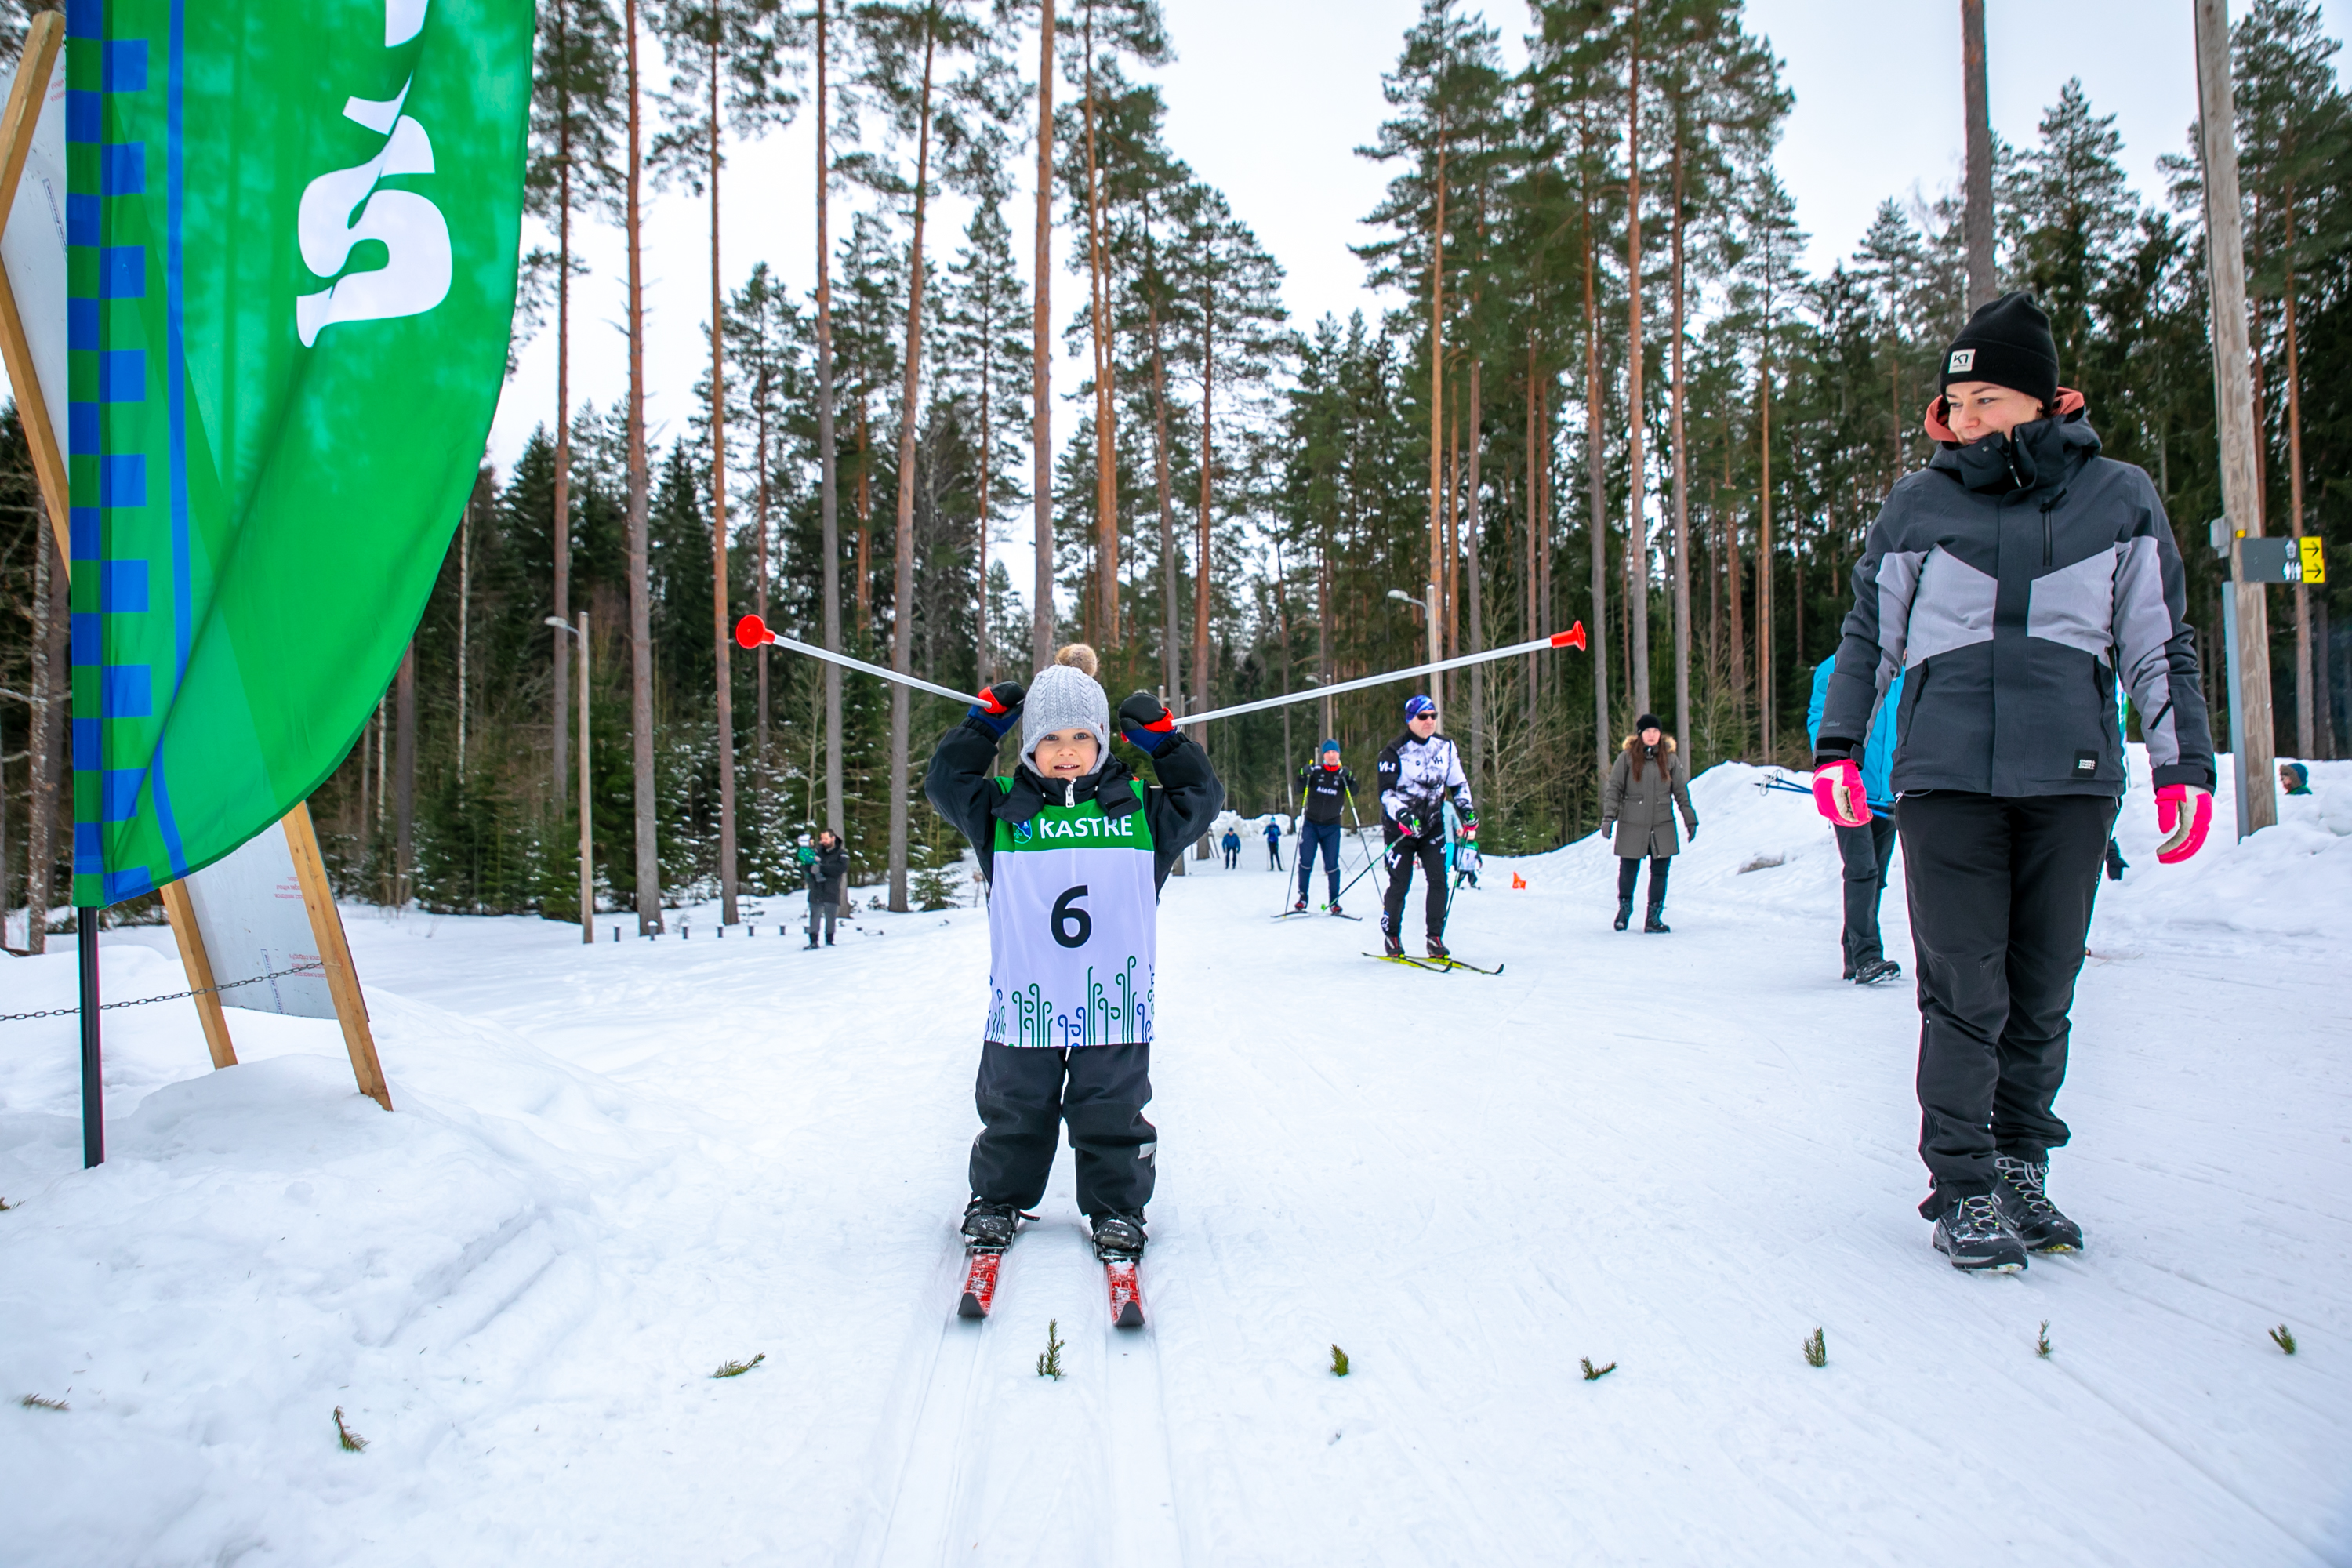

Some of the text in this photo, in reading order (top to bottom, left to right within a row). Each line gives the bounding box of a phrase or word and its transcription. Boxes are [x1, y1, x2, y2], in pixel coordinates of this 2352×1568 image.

[1378, 760, 1396, 772] VH
[1040, 815, 1134, 840] KASTRE
[1051, 884, 1092, 949] 6
